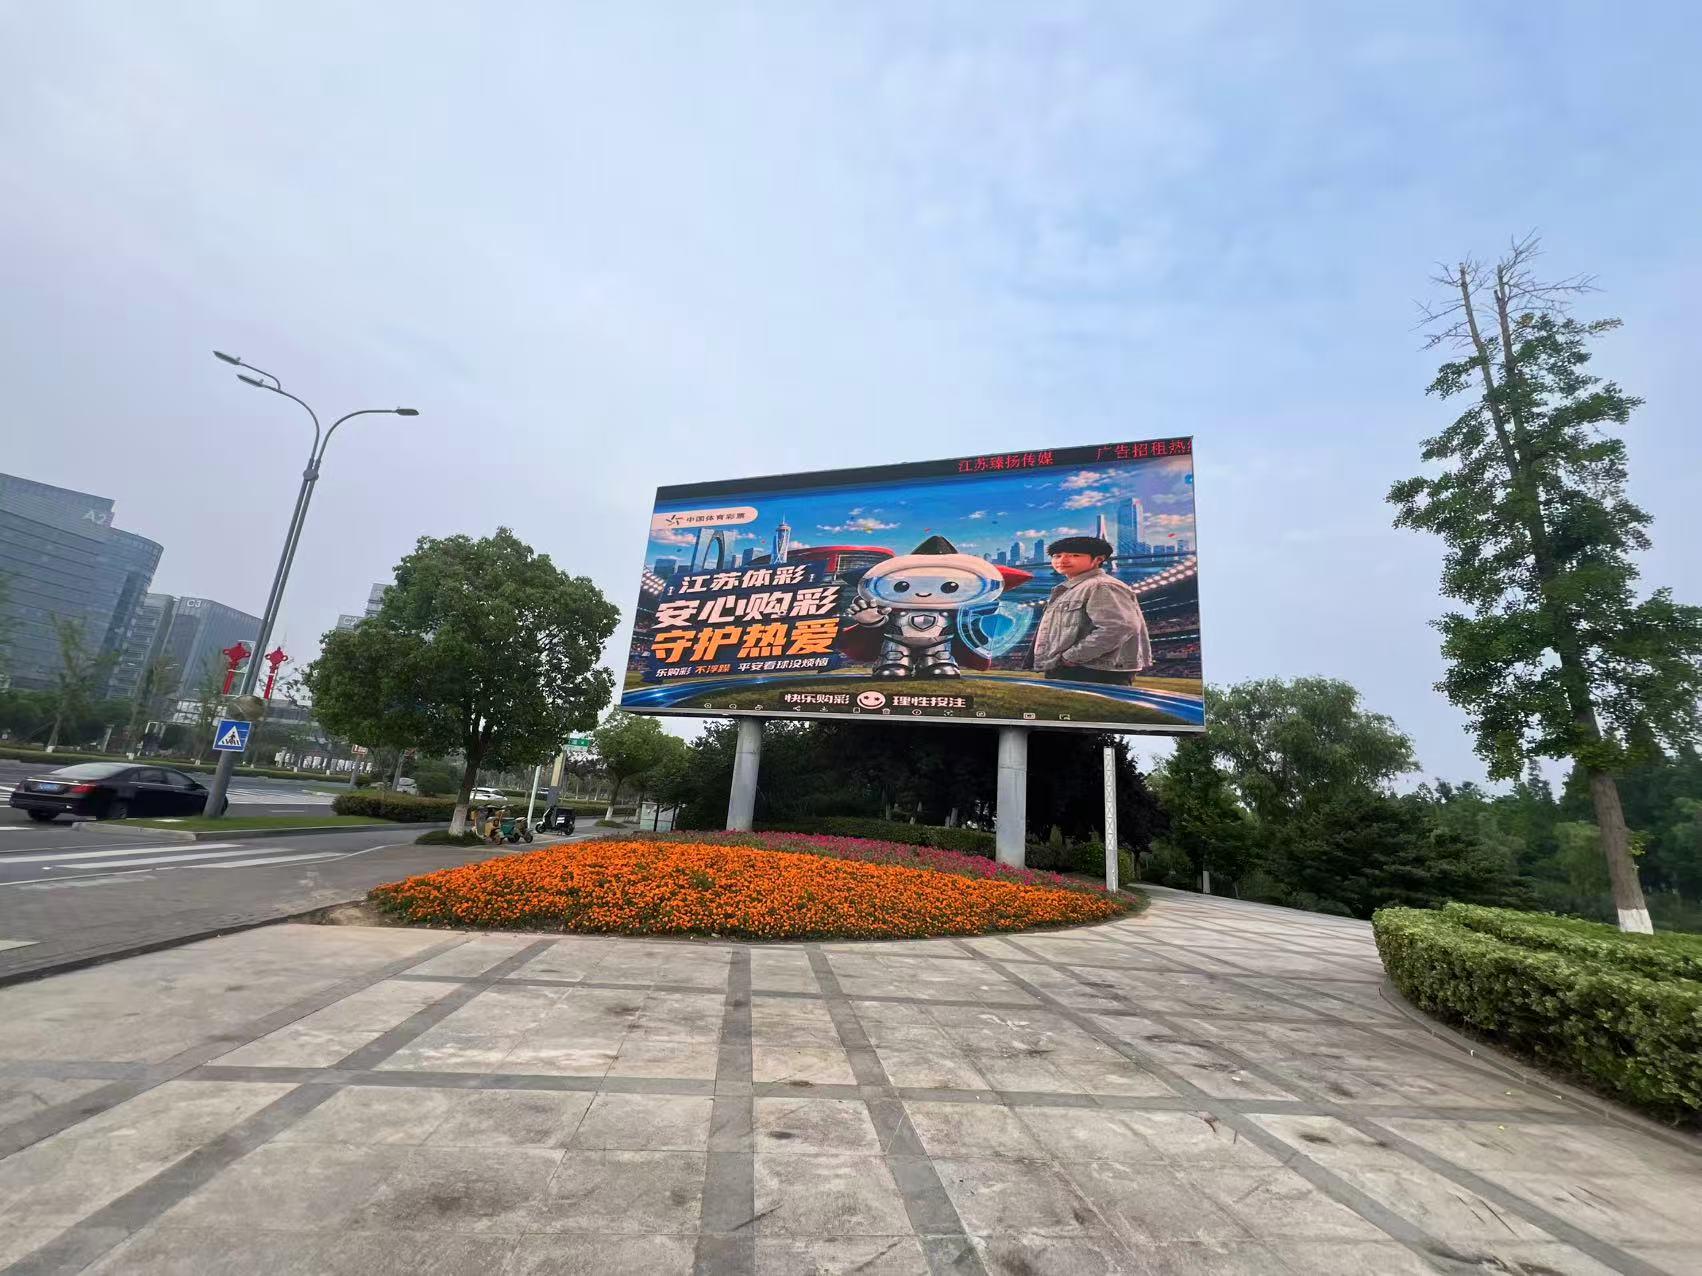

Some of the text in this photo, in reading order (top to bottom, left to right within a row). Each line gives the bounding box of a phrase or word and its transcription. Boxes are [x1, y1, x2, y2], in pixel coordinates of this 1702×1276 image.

[686, 512, 745, 523] 中国体育彩票
[679, 564, 808, 594] 江苏体彩
[187, 599, 201, 608] C3
[651, 586, 840, 629] 安心购彩
[650, 618, 840, 663] 守护热爱
[655, 657, 830, 677] 乐购彩 不浮躁 平安看球没烦恼
[784, 693, 967, 708] 快乐购彩 理性投注
